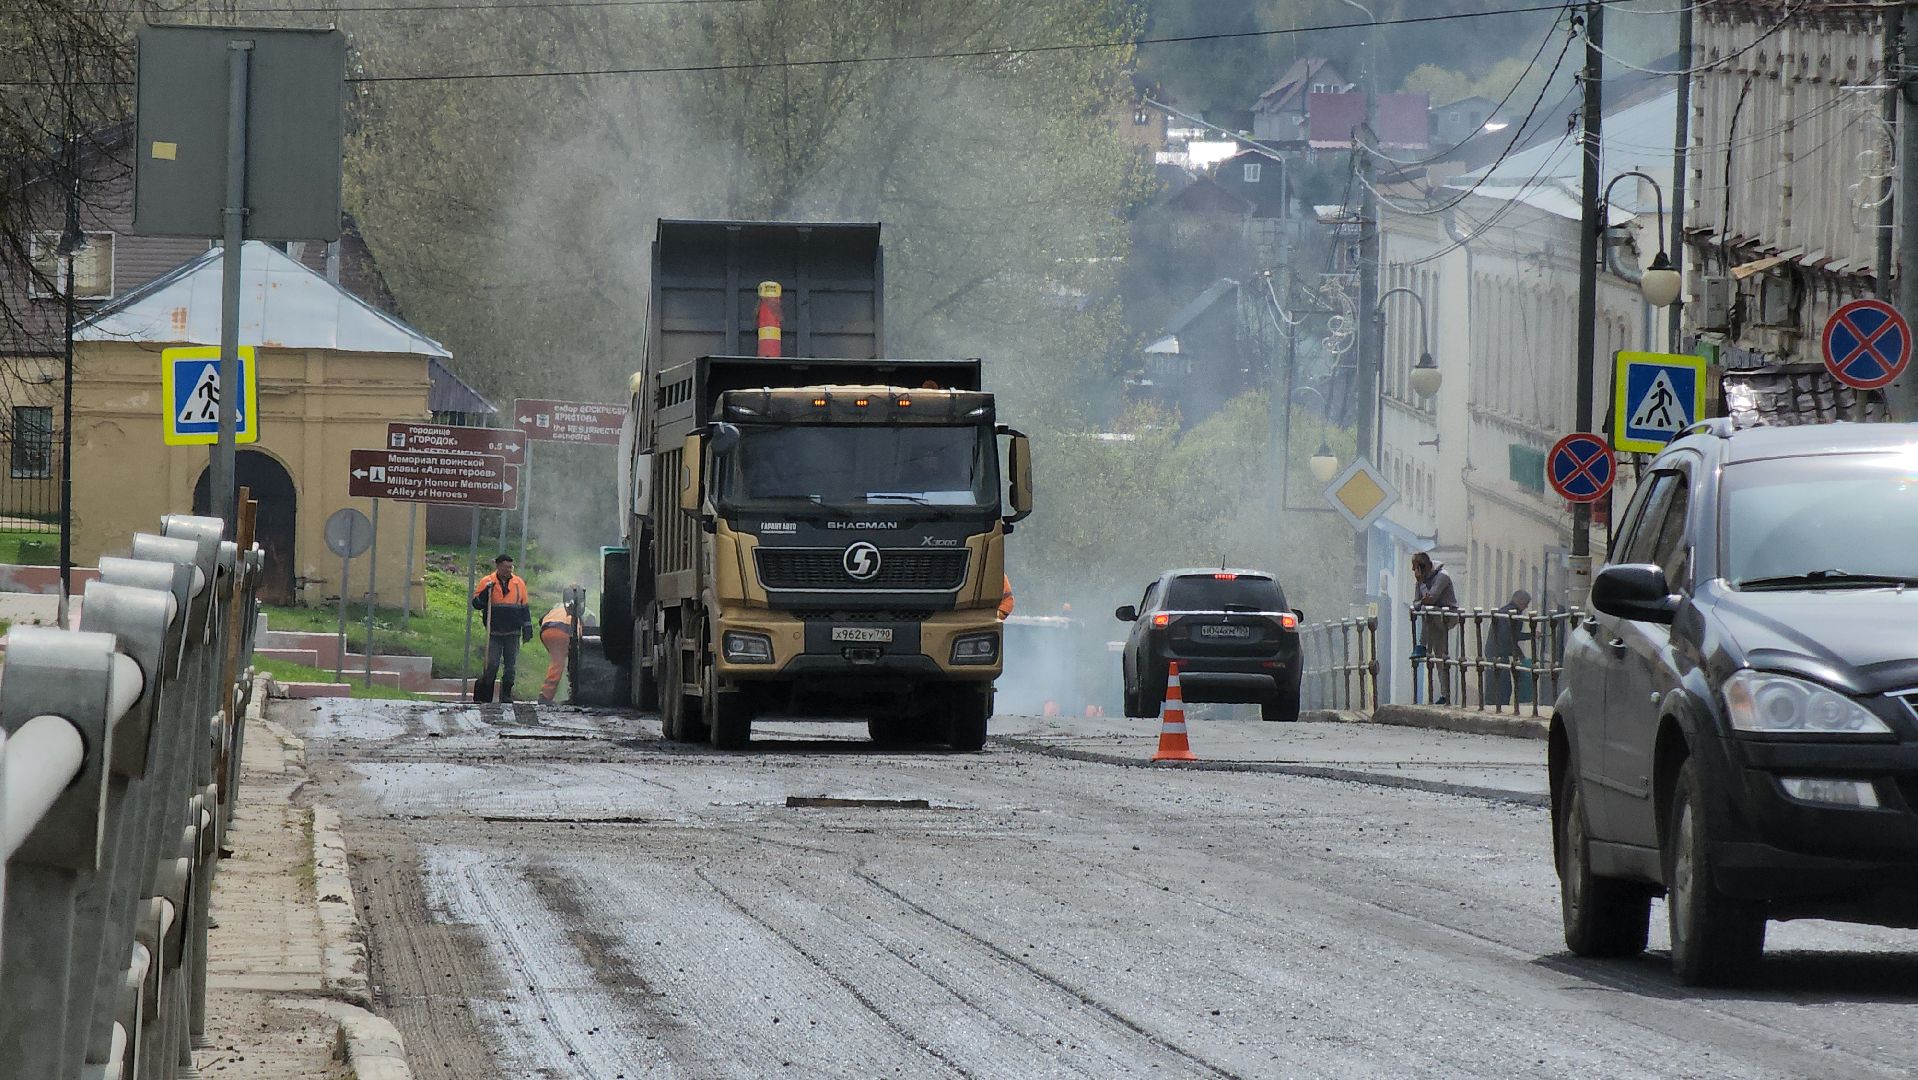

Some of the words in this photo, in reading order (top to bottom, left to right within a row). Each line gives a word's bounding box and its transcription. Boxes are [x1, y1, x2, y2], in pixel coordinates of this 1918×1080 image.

[409, 426, 451, 437] городище
[388, 454, 438, 466] Мемориал
[439, 457, 485, 467] воинской
[387, 465, 420, 473] славы
[387, 476, 423, 487] Military
[424, 478, 459, 488] Honour
[460, 480, 502, 490] Memorial
[387, 487, 416, 498] «Alley
[418, 488, 428, 497] of
[827, 521, 898, 529] SHACMAN
[921, 535, 957, 546] X3000
